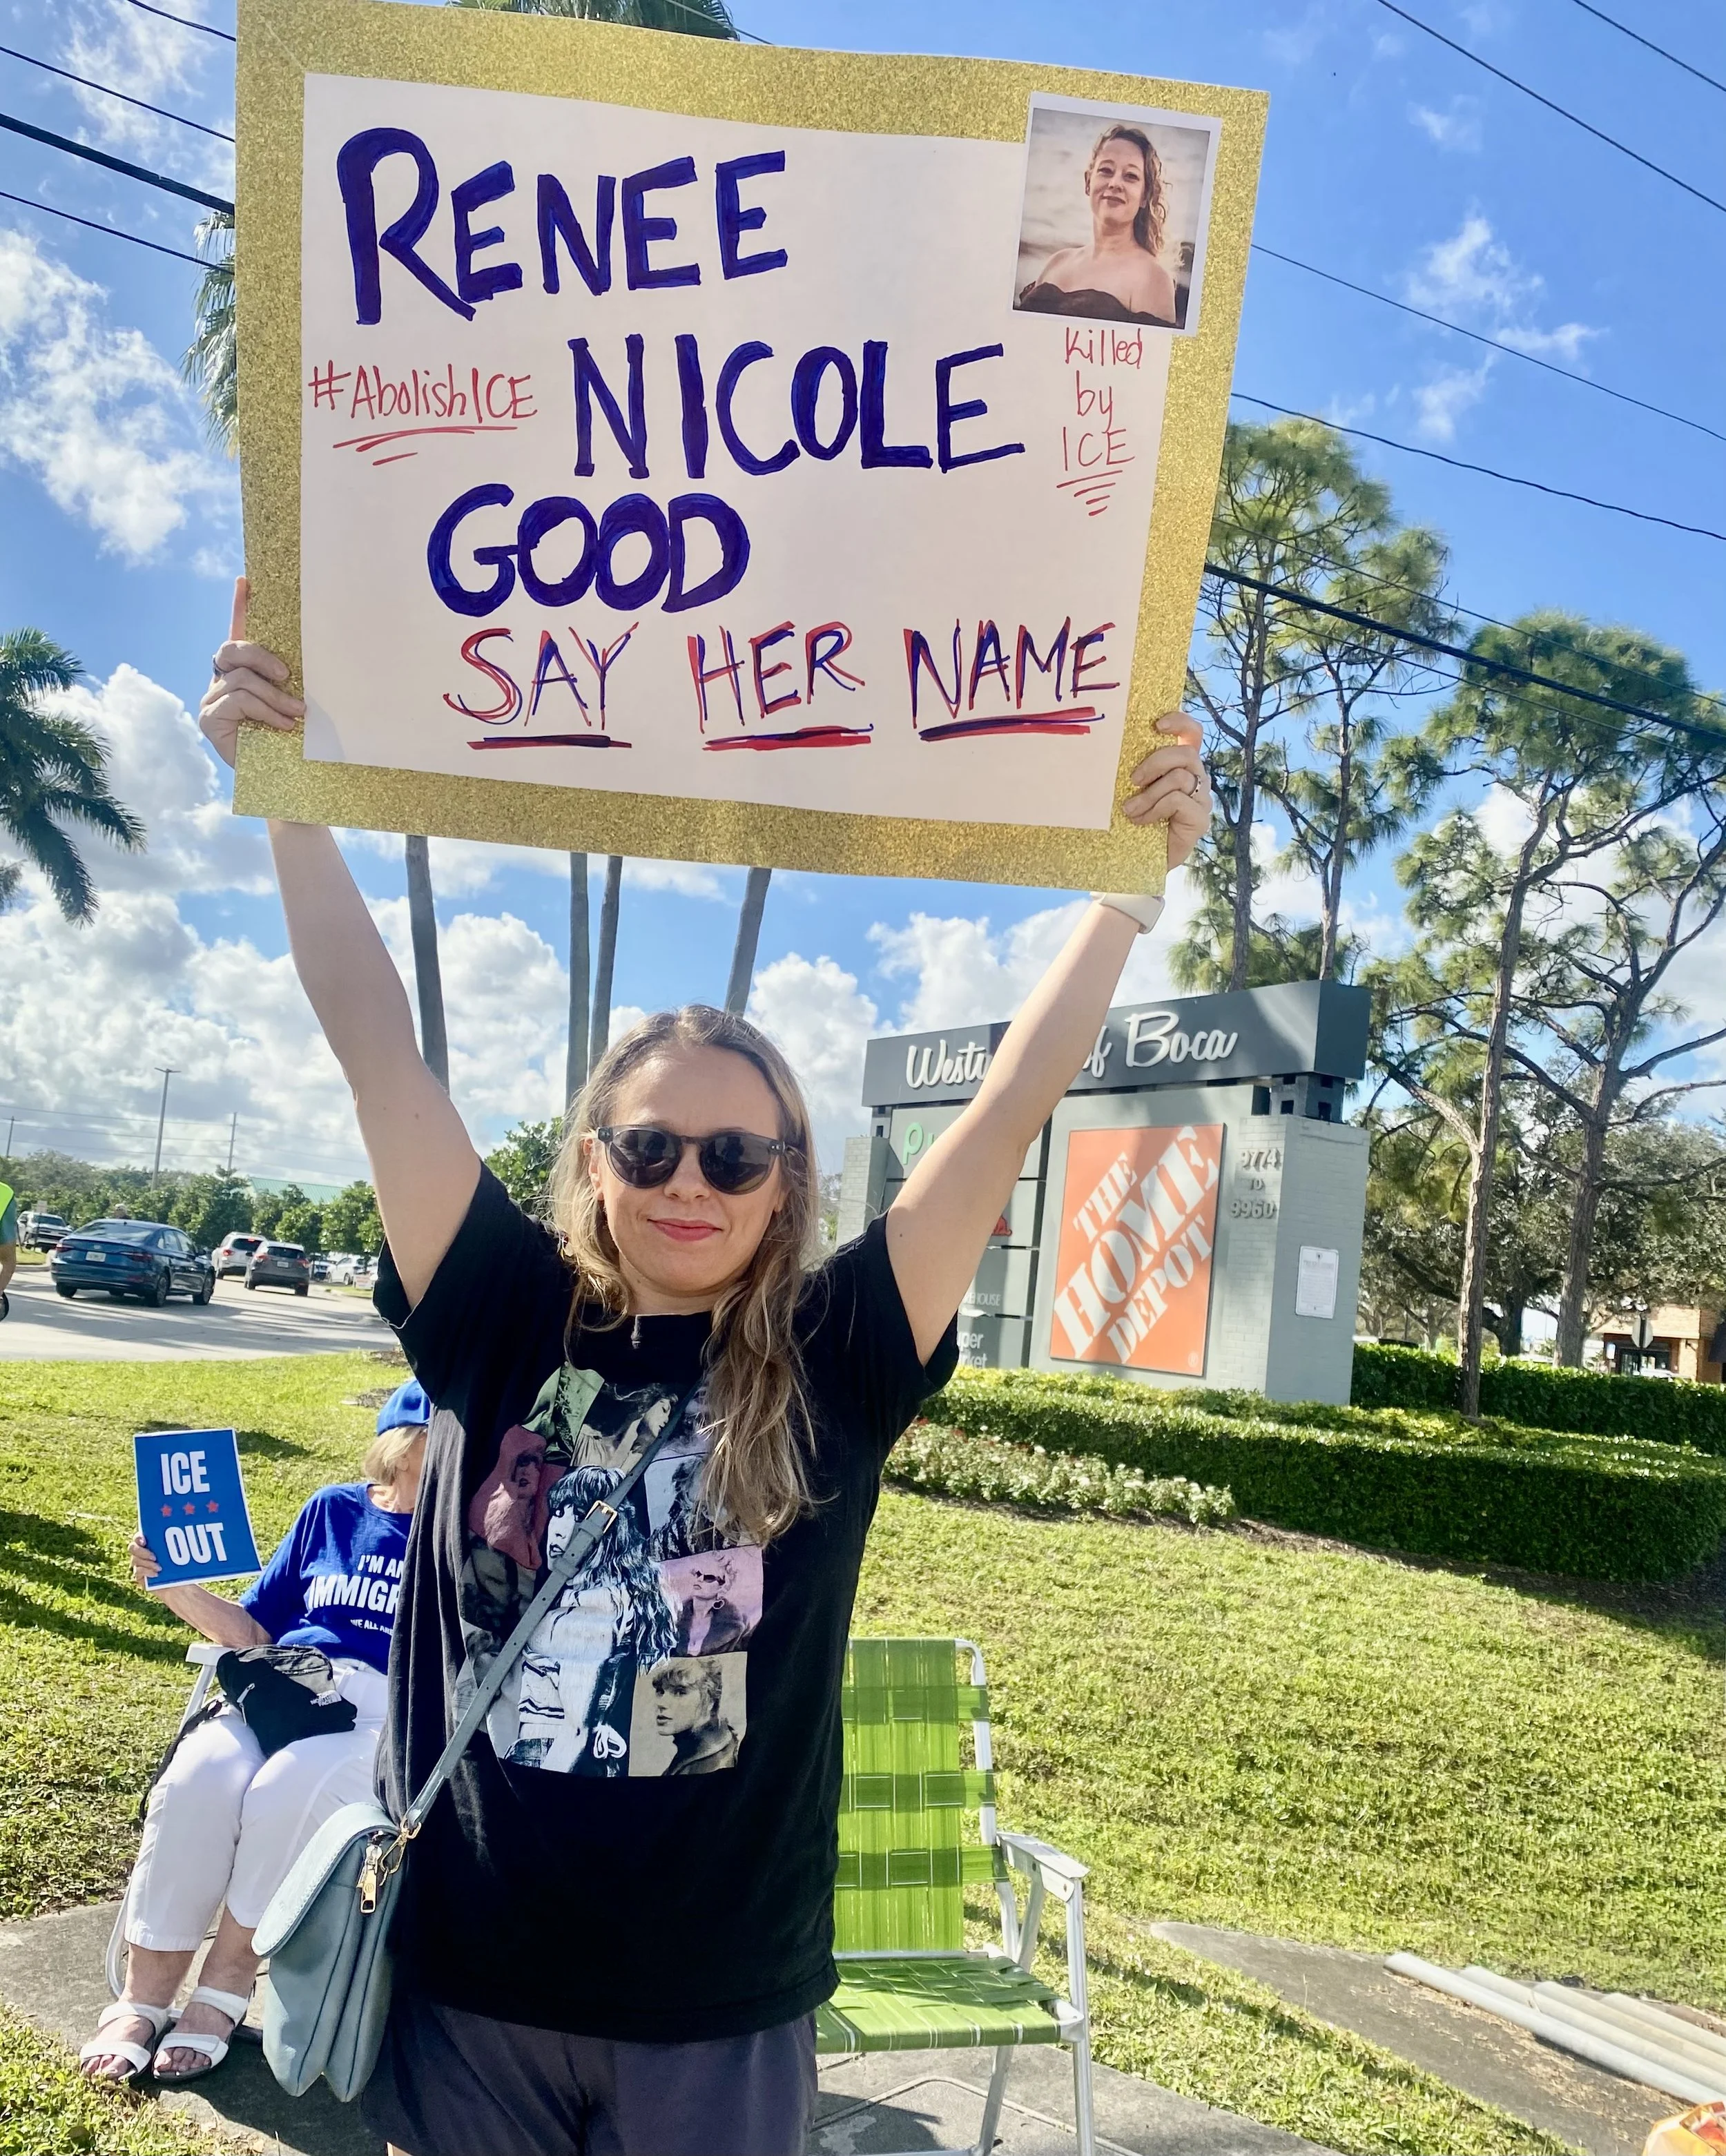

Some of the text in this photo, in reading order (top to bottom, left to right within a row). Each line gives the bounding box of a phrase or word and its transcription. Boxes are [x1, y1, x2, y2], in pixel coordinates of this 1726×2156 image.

[337, 127, 788, 325] RENEE
[309, 360, 538, 424] #AbolishICE
[568, 334, 1025, 478] NICOLE
[1076, 370, 1113, 434] by
[1063, 427, 1135, 471] ICE
[427, 483, 751, 616] GOOD
[443, 619, 1119, 730] SAY HER NAME
[1082, 1025, 1112, 1078] f
[1124, 1011, 1239, 1067] Boca
[1241, 1148, 1278, 1169] 9774
[1073, 1152, 1138, 1243] THE
[1231, 1200, 1276, 1218] 9960
[1054, 1126, 1219, 1359] HOME
[1107, 1214, 1212, 1364] DEPOT
[160, 1450, 211, 1495] ICE
[164, 1522, 228, 1566] OUT
[364, 1620, 379, 1631] ALL
